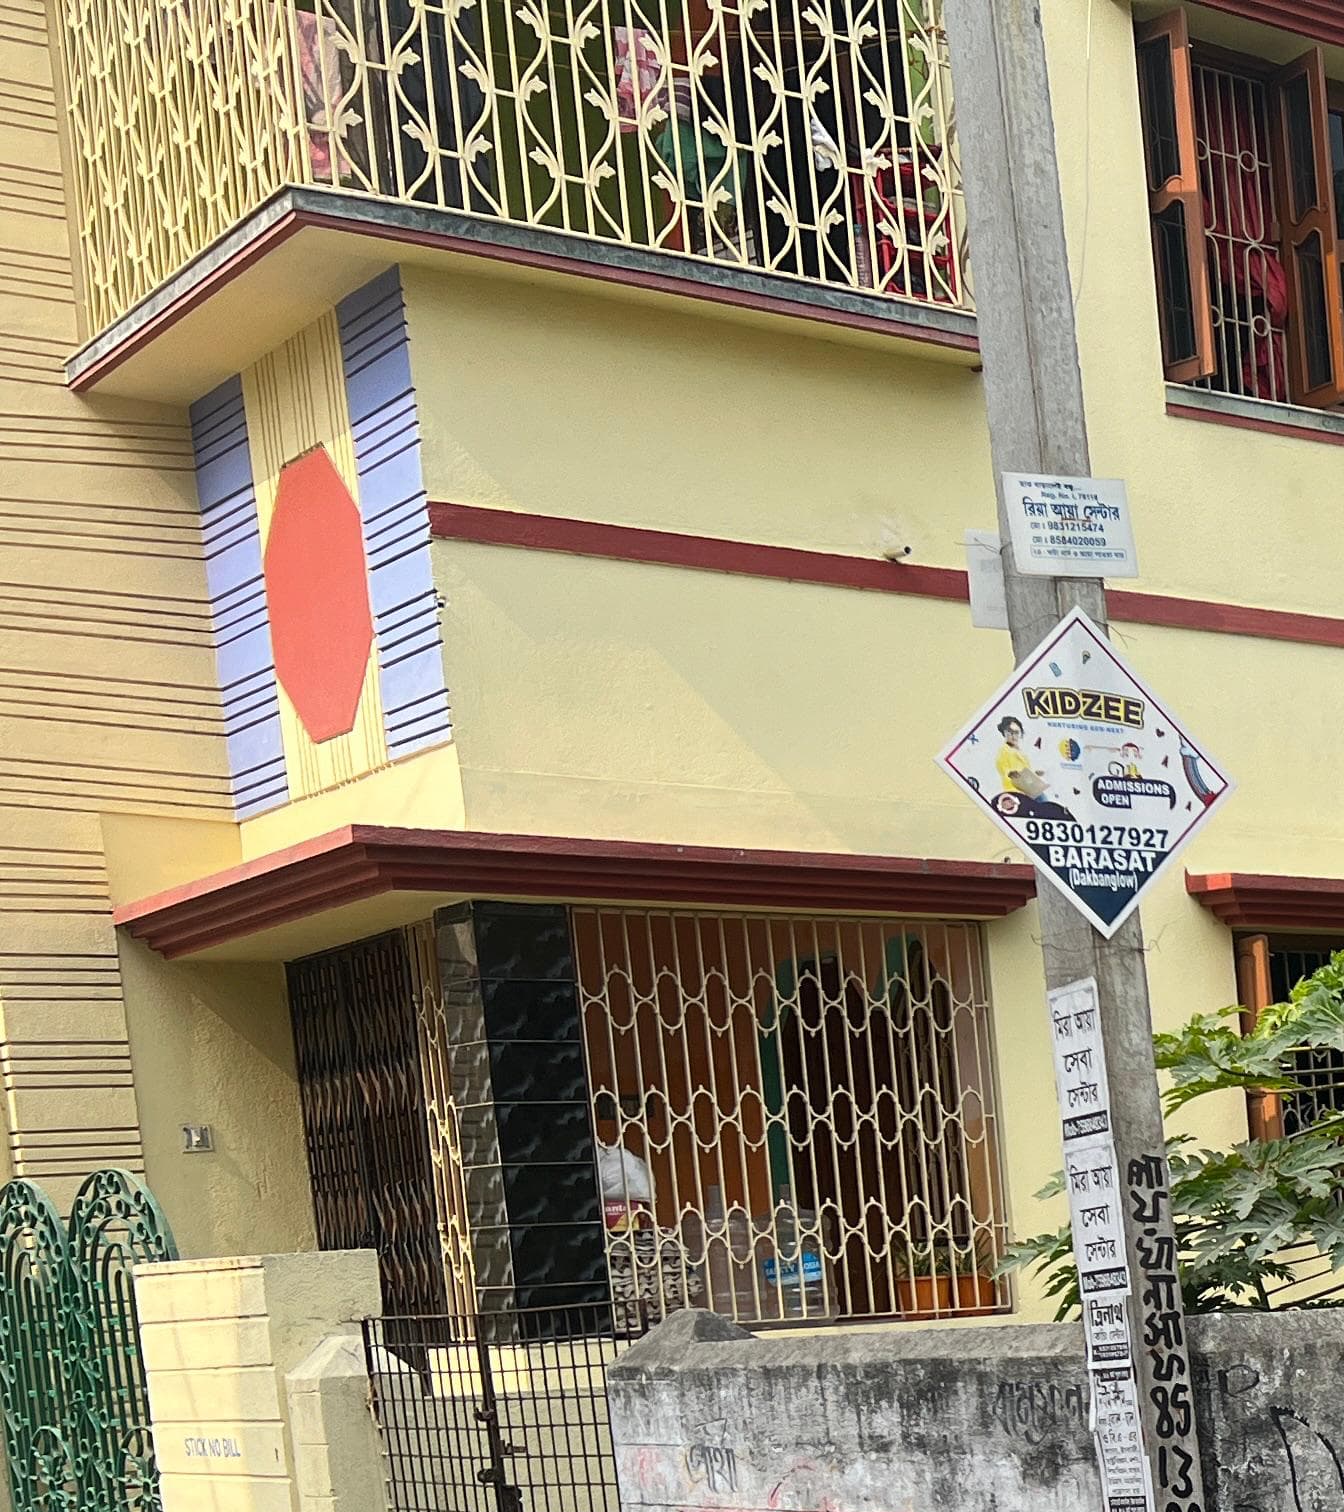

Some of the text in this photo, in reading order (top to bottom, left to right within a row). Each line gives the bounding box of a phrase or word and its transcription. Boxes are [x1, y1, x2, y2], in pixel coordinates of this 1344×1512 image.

[1024, 688, 1144, 729] KIDZEE
[1097, 779, 1170, 796] ADMISSIONS
[1101, 794, 1130, 807] OPEN
[1026, 820, 1169, 849] 9830127927
[1049, 846, 1156, 872] BARASAT
[1069, 868, 1138, 892] (Dakbanglow)
[1062, 1048, 1092, 1075] সেবা
[1067, 1081, 1098, 1108] সেন্টার
[1080, 1203, 1110, 1228] সেবা
[1084, 1237, 1117, 1262] সেন্টার
